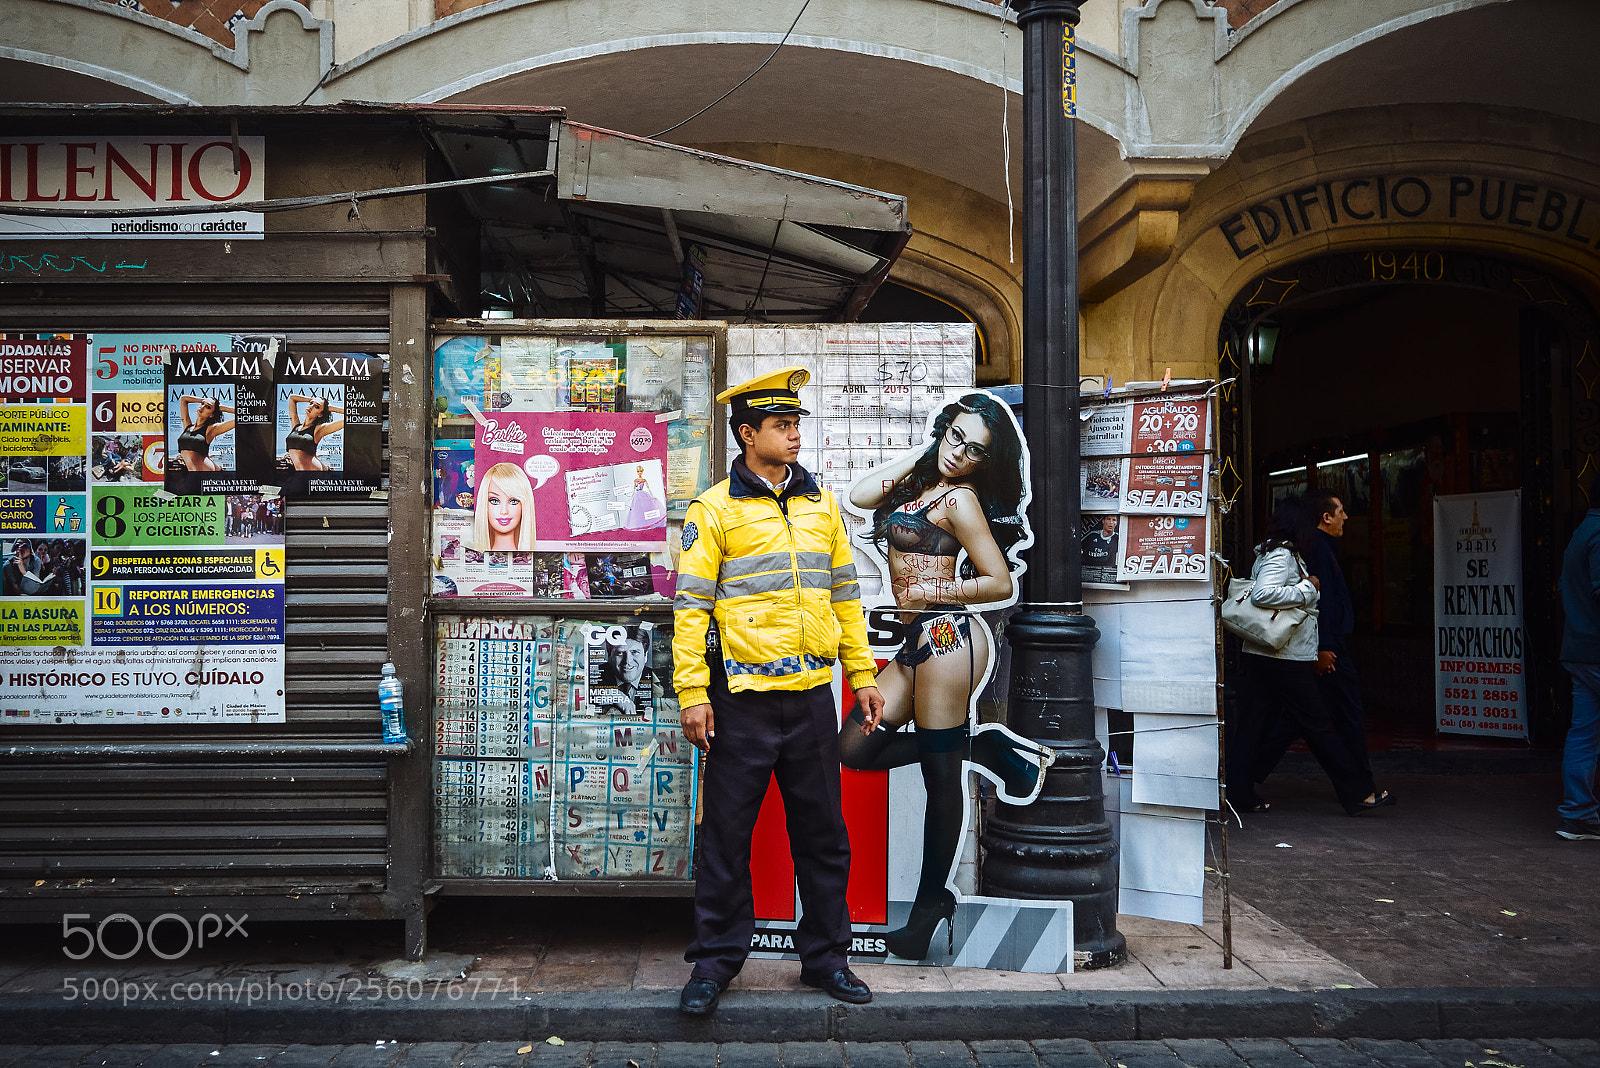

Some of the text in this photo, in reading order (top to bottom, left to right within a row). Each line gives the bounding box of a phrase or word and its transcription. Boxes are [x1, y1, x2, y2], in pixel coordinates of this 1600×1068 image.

[1219, 176, 1600, 260] EDIFICIO PUEBL
[1364, 251, 1444, 282] 1940
[123, 344, 138, 352] NO
[96, 344, 118, 380] 5
[123, 356, 136, 366] NI
[175, 357, 261, 376] MAXIM
[284, 357, 371, 376] MAXIM
[874, 357, 928, 384] $70
[170, 387, 233, 402] MAXIM
[237, 391, 256, 399] GUÍA
[280, 387, 342, 401] MAXIM
[346, 391, 365, 400] GUÍA
[842, 386, 868, 394] ABRIL
[884, 386, 909, 394] 2015
[30, 408, 70, 419] PÚBLICO
[95, 400, 114, 423] 6
[121, 402, 142, 412] NO
[1142, 406, 1198, 415] AGUINALDO
[482, 418, 528, 445] Barbie
[1088, 425, 1110, 433] Ajusco
[1088, 433, 1118, 441] patrullar
[152, 448, 164, 470] 7
[27, 498, 34, 508] Y
[133, 496, 216, 508] RESPETAR A
[1126, 490, 1202, 508] SEARS
[95, 496, 126, 538] 8
[133, 512, 217, 522] LOS PEATONES
[133, 526, 219, 536] Y CICLISTAS.
[1456, 540, 1496, 553] PARIS
[92, 556, 110, 576] 9
[1123, 554, 1206, 574] SEARS
[1466, 559, 1490, 579] SE
[96, 591, 121, 610] 10
[129, 589, 275, 600] REPORTAR EMERGENCIAS
[1443, 584, 1516, 616] RENTAN
[2, 608, 78, 620] LA BASURA
[129, 601, 250, 616] A LOS NÚMEROS:
[8, 624, 20, 632] EN
[23, 624, 40, 632] LAS
[868, 606, 906, 646] S
[588, 626, 628, 646] GQ
[1438, 627, 1522, 660] DESPACHOS
[1440, 660, 1522, 675] INFORMES
[9, 668, 264, 687] HISTÓRICO ES TUYO, CUÍDALO
[1461, 677, 1479, 685] LOS
[1481, 677, 1508, 686] TELS:
[534, 686, 548, 708] G
[1444, 688, 1518, 702] 5521 2858
[466, 711, 518, 722] 14 21
[1444, 705, 1518, 719] 5521 3031
[465, 723, 519, 732] 16 24
[506, 735, 519, 744] 27
[535, 765, 548, 790] Ñ
[570, 767, 584, 792] P
[613, 768, 630, 792] Q
[656, 771, 674, 795] R
[505, 822, 516, 830] 42
[568, 806, 582, 828] S
[612, 809, 627, 829] T
[654, 810, 668, 831] V
[652, 850, 664, 872] Z
[750, 933, 886, 952] PARA RES
